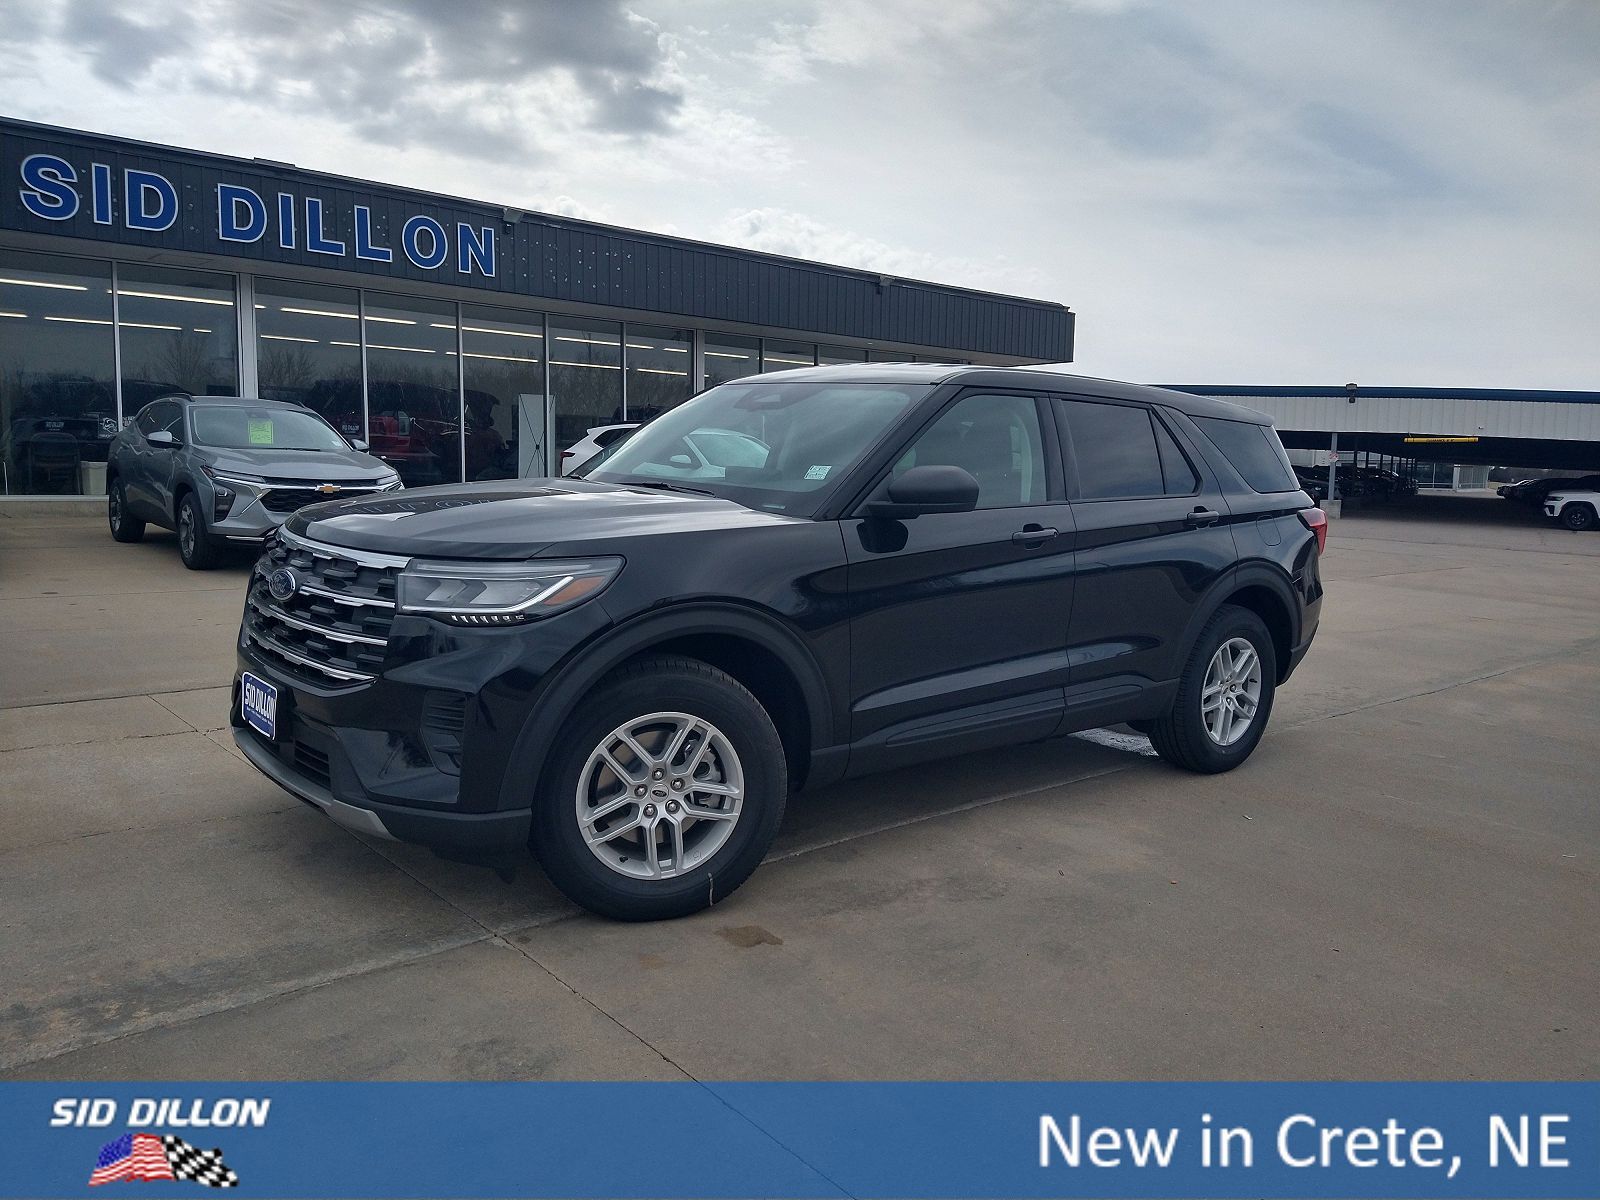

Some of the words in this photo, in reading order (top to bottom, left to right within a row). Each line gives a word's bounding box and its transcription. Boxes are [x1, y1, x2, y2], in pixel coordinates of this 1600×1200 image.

[19, 153, 180, 232] SID
[217, 182, 497, 278] DILLON
[244, 682, 256, 709] SID
[255, 687, 276, 723] DILLON
